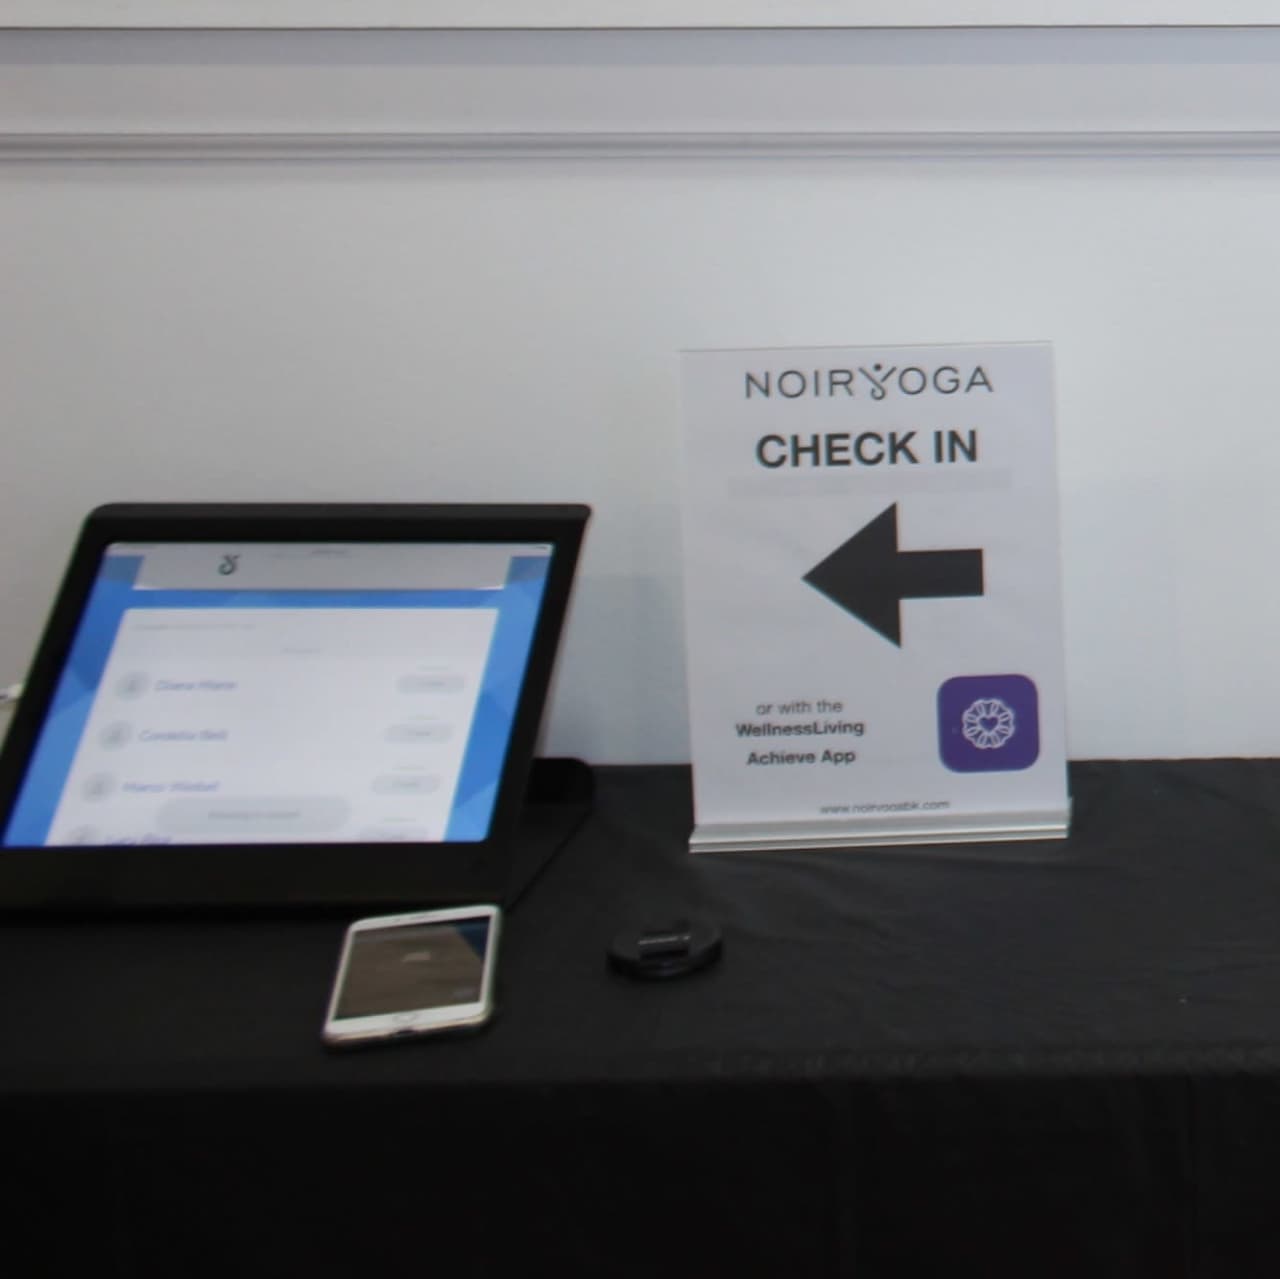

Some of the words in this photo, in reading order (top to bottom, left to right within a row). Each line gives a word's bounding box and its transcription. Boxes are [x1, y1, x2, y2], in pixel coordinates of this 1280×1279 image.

[744, 363, 994, 401] NOIRYOGA
[755, 430, 920, 468] CHECK
[933, 429, 978, 463] IN
[756, 704, 773, 716] or
[777, 700, 812, 715] with
[816, 699, 844, 713] the
[736, 721, 865, 738] WellnessLiving
[746, 750, 816, 766] Achieve
[821, 749, 857, 765] App
